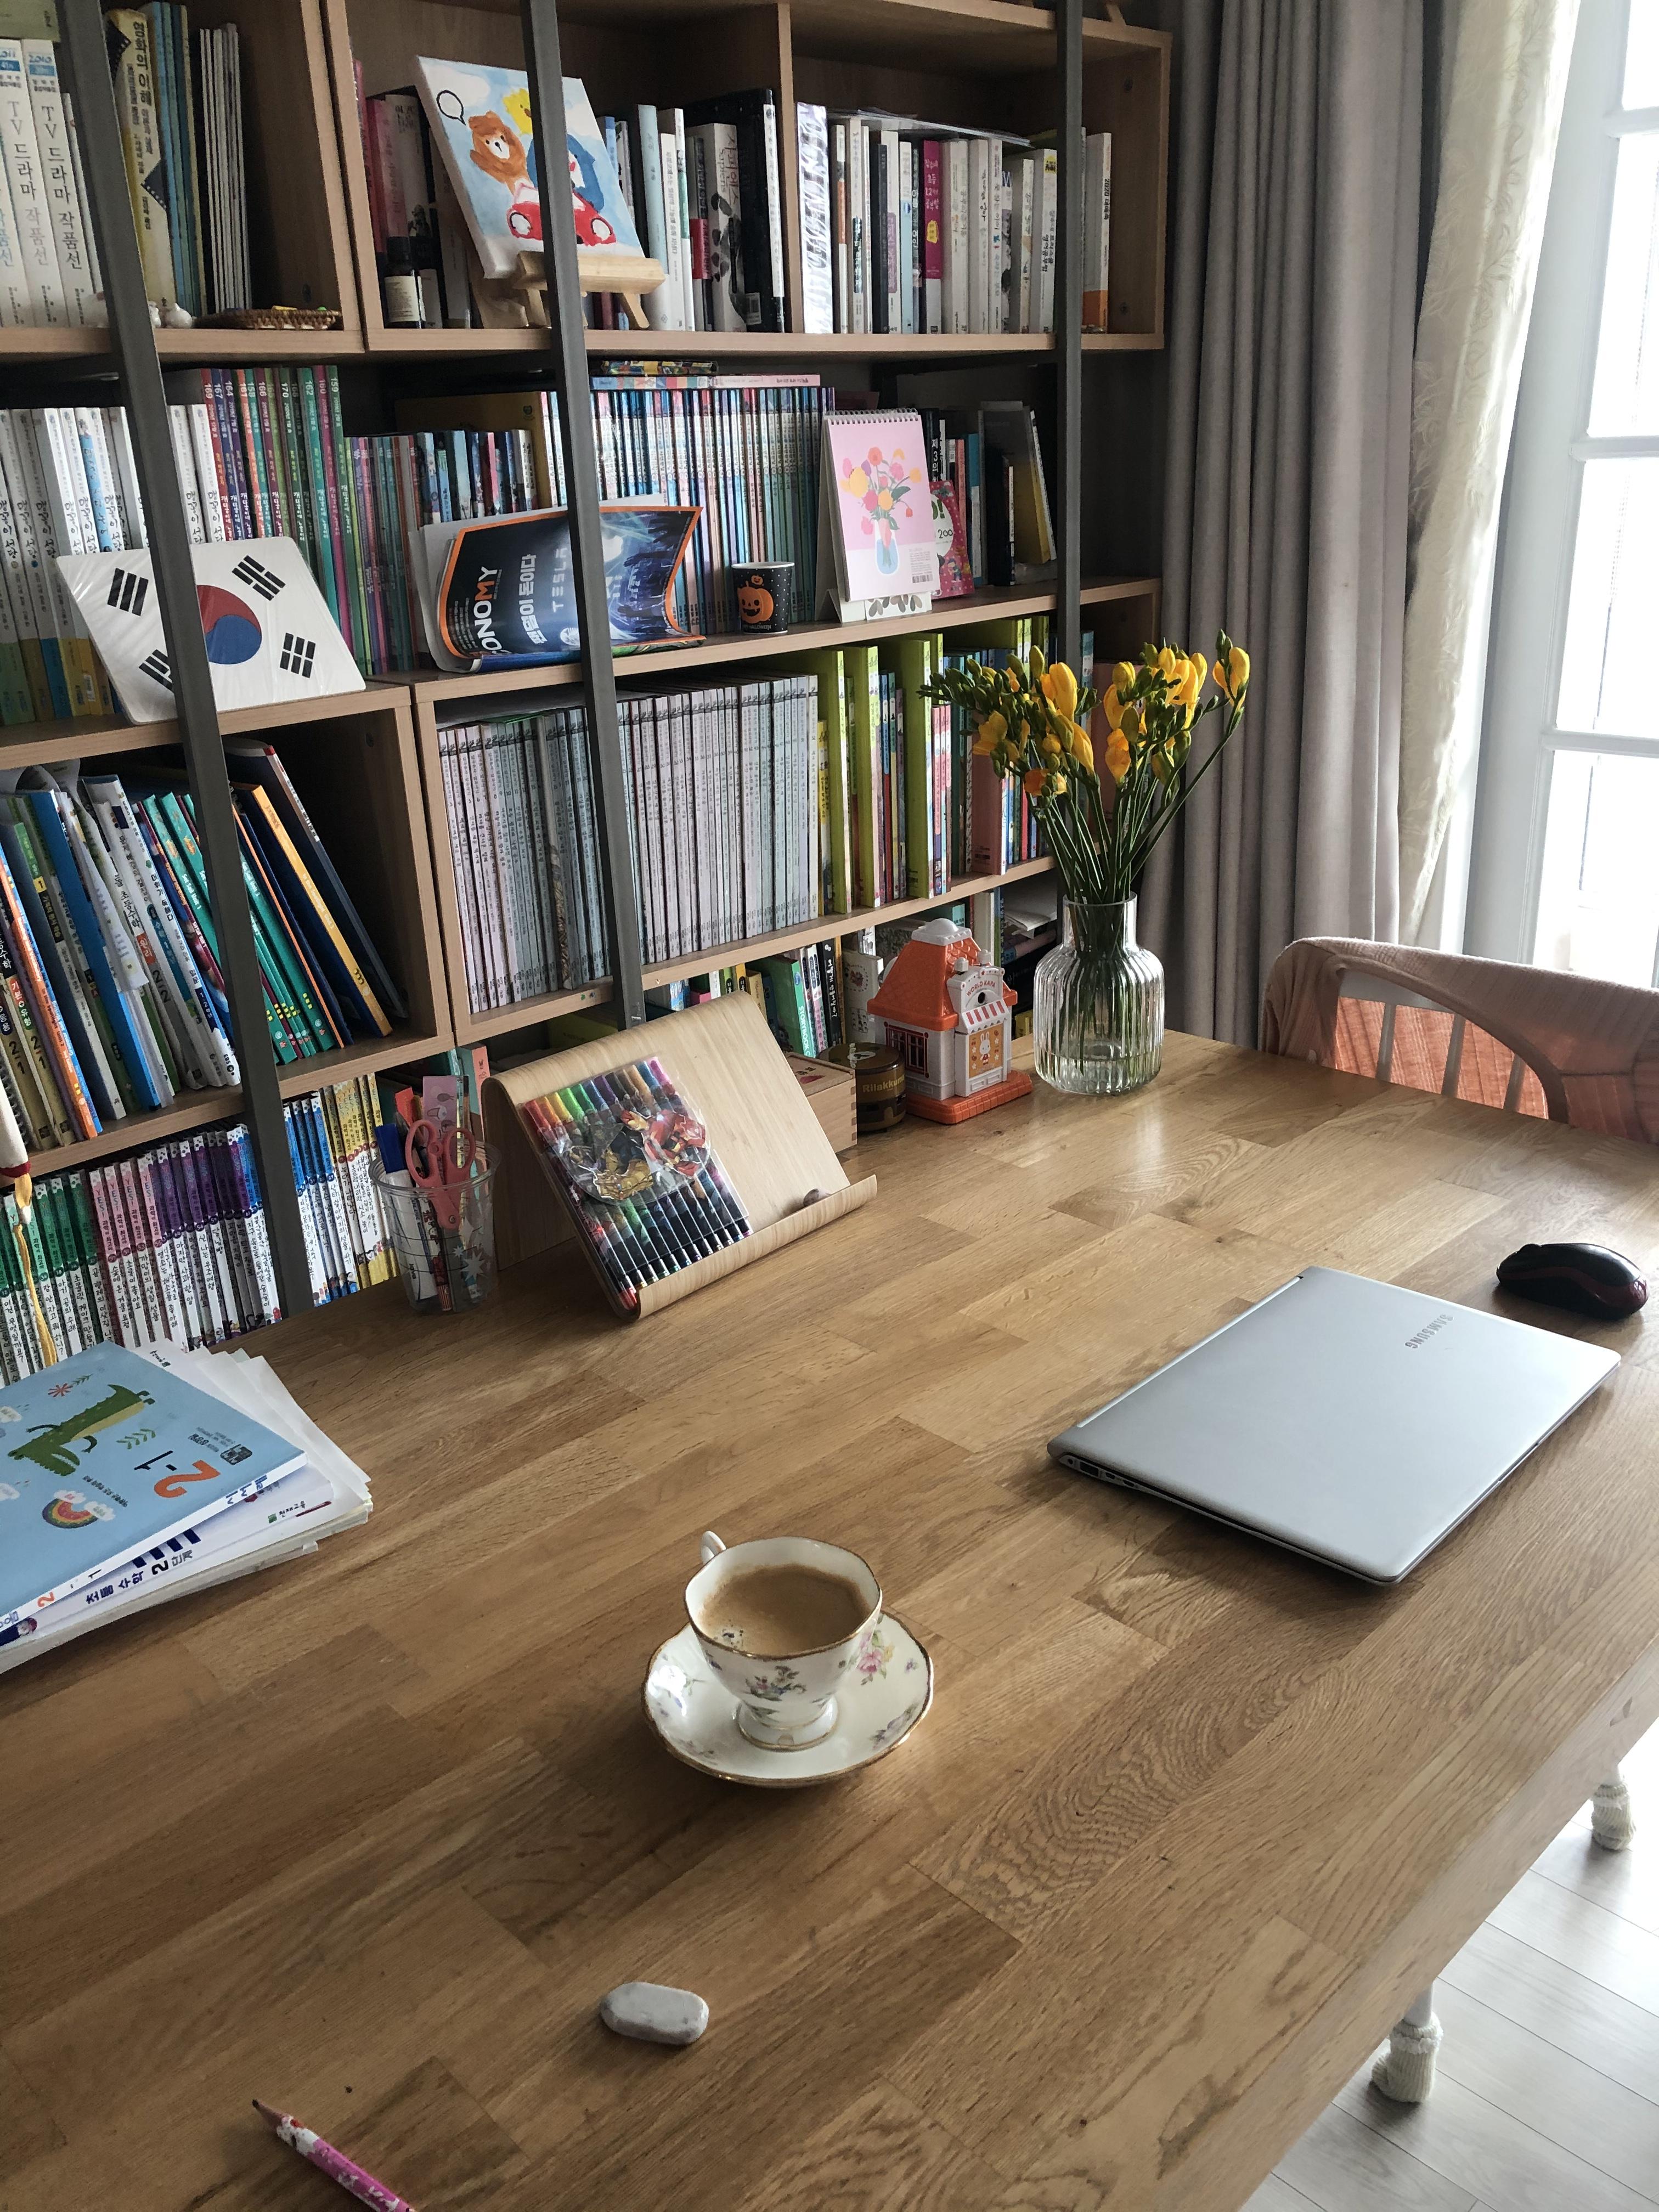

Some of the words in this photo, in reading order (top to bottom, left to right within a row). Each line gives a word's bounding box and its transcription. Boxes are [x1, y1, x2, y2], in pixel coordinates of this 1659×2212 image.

[8, 101, 22, 135] TV
[42, 106, 57, 139] TV
[14, 143, 37, 201] 드라마
[48, 147, 71, 204] 드라마
[727, 132, 739, 201] 사피엔스
[25, 207, 48, 266] 작품선
[58, 211, 82, 269] 작품선
[204, 383, 213, 399] 169
[214, 383, 223, 399] 167
[225, 380, 234, 396] 164
[258, 381, 267, 397] 166
[281, 382, 289, 398] 170
[305, 380, 314, 396] 162
[330, 377, 340, 392] 159
[105, 495, 119, 529] 맹꽁이
[112, 532, 123, 551] 서당
[186, 491, 200, 523] 맹꽁이
[193, 527, 203, 544] 서당
[207, 491, 221, 523] 맹꽁이
[17, 500, 32, 535] 맹꽁이
[26, 538, 38, 558] 서당
[36, 500, 52, 535] 맹꽁이
[45, 538, 56, 558] 서당
[78, 496, 93, 531] 맹꽁이
[87, 534, 97, 553] 서당
[213, 527, 224, 543] 서당
[938, 529, 953, 539] 200
[518, 554, 537, 596] 돈이다
[551, 548, 568, 613] TESLA
[518, 599, 548, 644] 팬덤이
[966, 981, 983, 997] WORLD
[984, 980, 996, 988] KAPA
[798, 1005, 809, 1049] STORYBOOK
[57, 1279, 68, 1294] 아기
[1404, 1314, 1454, 1348] SAMSUNG
[278, 1499, 307, 1518] 천재교육
[85, 1583, 115, 1605] 초등
[117, 1570, 145, 1590] 수학
[151, 1559, 170, 1576] 2
[171, 1548, 194, 1567] 단계
